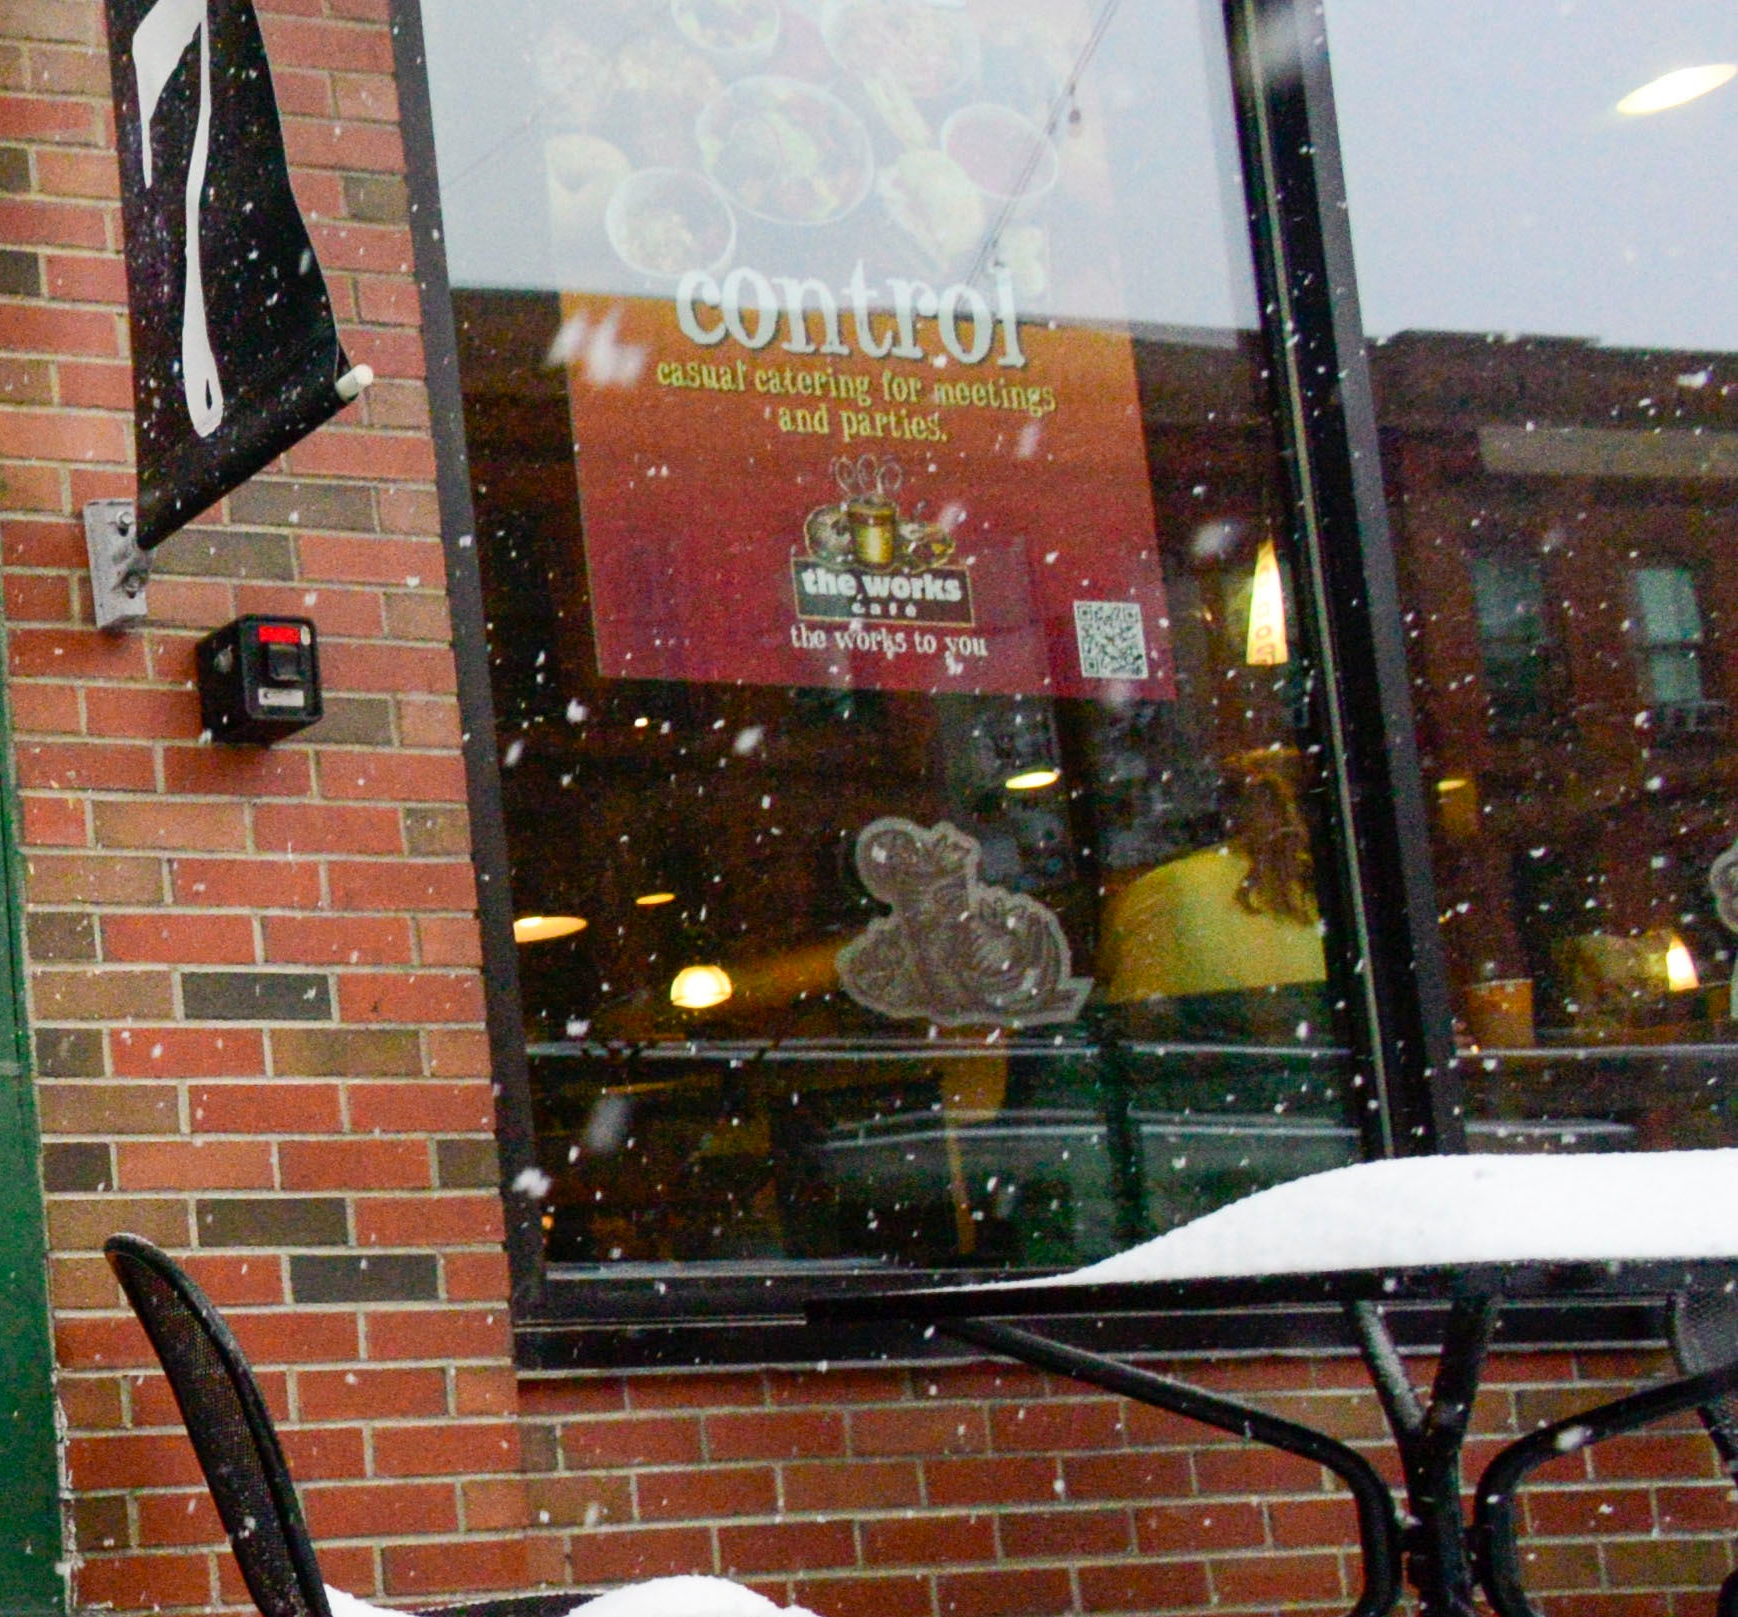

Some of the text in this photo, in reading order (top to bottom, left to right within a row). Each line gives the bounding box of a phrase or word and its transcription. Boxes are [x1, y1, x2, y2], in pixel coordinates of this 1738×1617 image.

[675, 259, 1027, 368] control
[656, 359, 1057, 418] casual catering for meetings
[778, 403, 949, 443] and parties.
[801, 567, 963, 602] the works
[790, 622, 989, 661] the works to you
